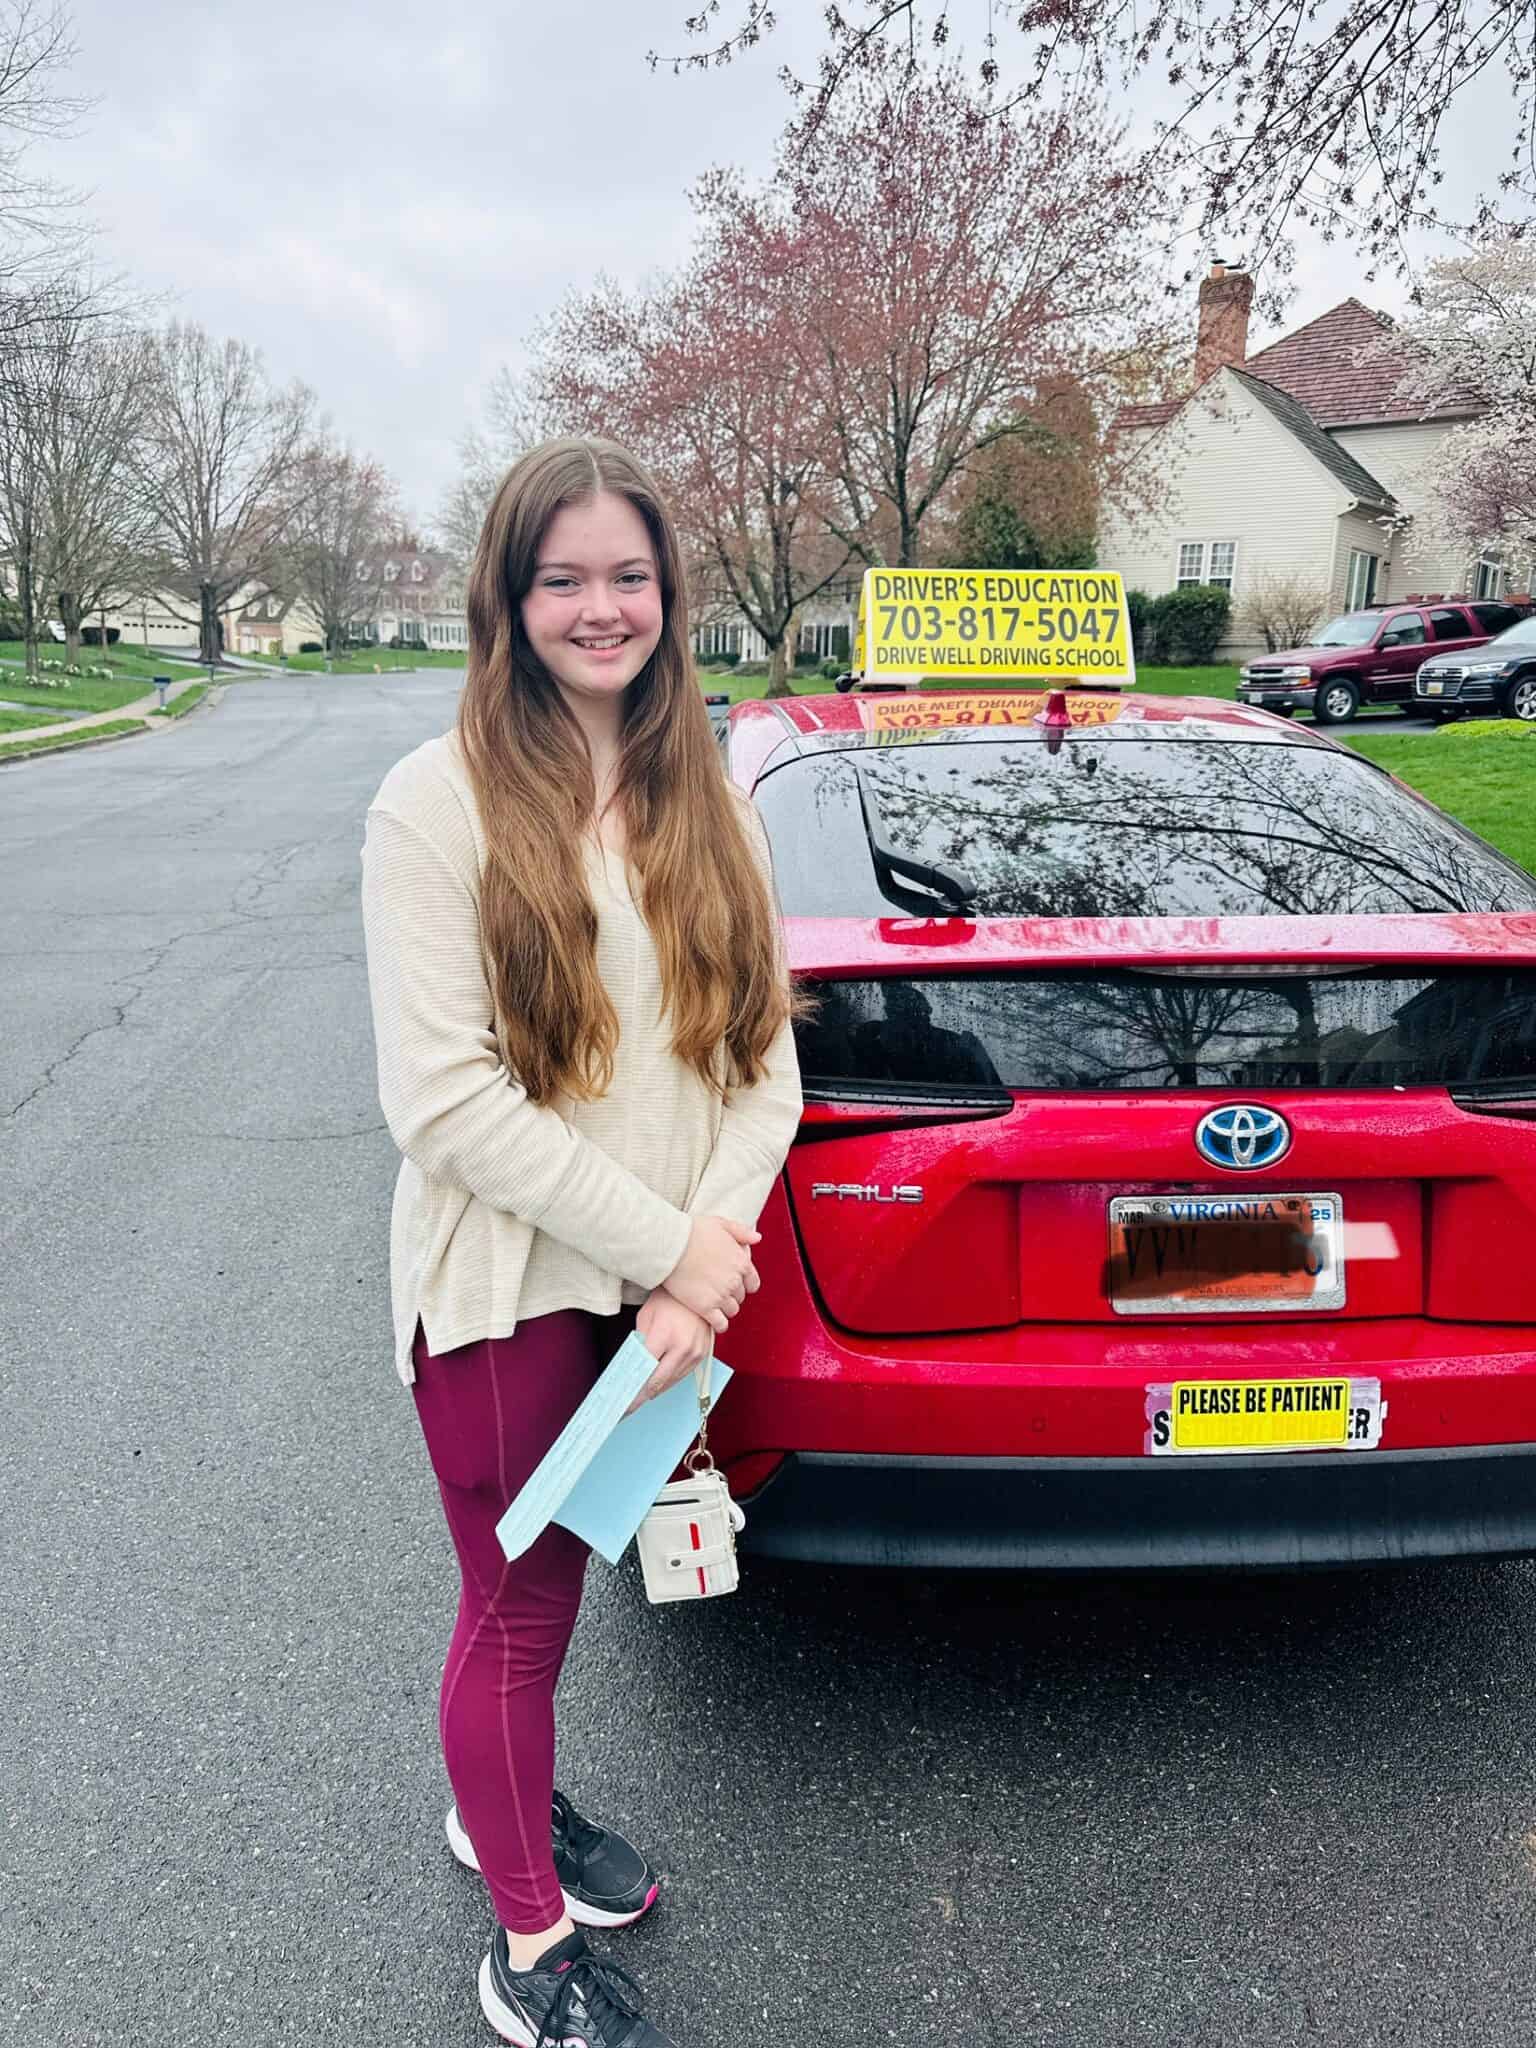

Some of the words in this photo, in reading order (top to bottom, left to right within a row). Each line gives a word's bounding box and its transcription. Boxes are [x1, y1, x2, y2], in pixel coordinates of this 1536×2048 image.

[875, 576, 978, 601] DRIVER'S
[984, 578, 1118, 603] EDUCATION
[879, 606, 1120, 643] 703-817-5047
[876, 647, 927, 665] DRIVE
[931, 648, 976, 666] WELL
[980, 648, 1051, 666] DRIVING
[1056, 648, 1125, 666] SCHOOL
[811, 1183, 923, 1202] PRIUS
[1118, 1211, 1144, 1224] MAR
[1169, 1202, 1280, 1222] VIRGINIA
[1310, 1208, 1331, 1220] 25
[1179, 1388, 1241, 1415] PLEASE
[1245, 1386, 1266, 1413] BE
[1271, 1385, 1344, 1412] PATIENT
